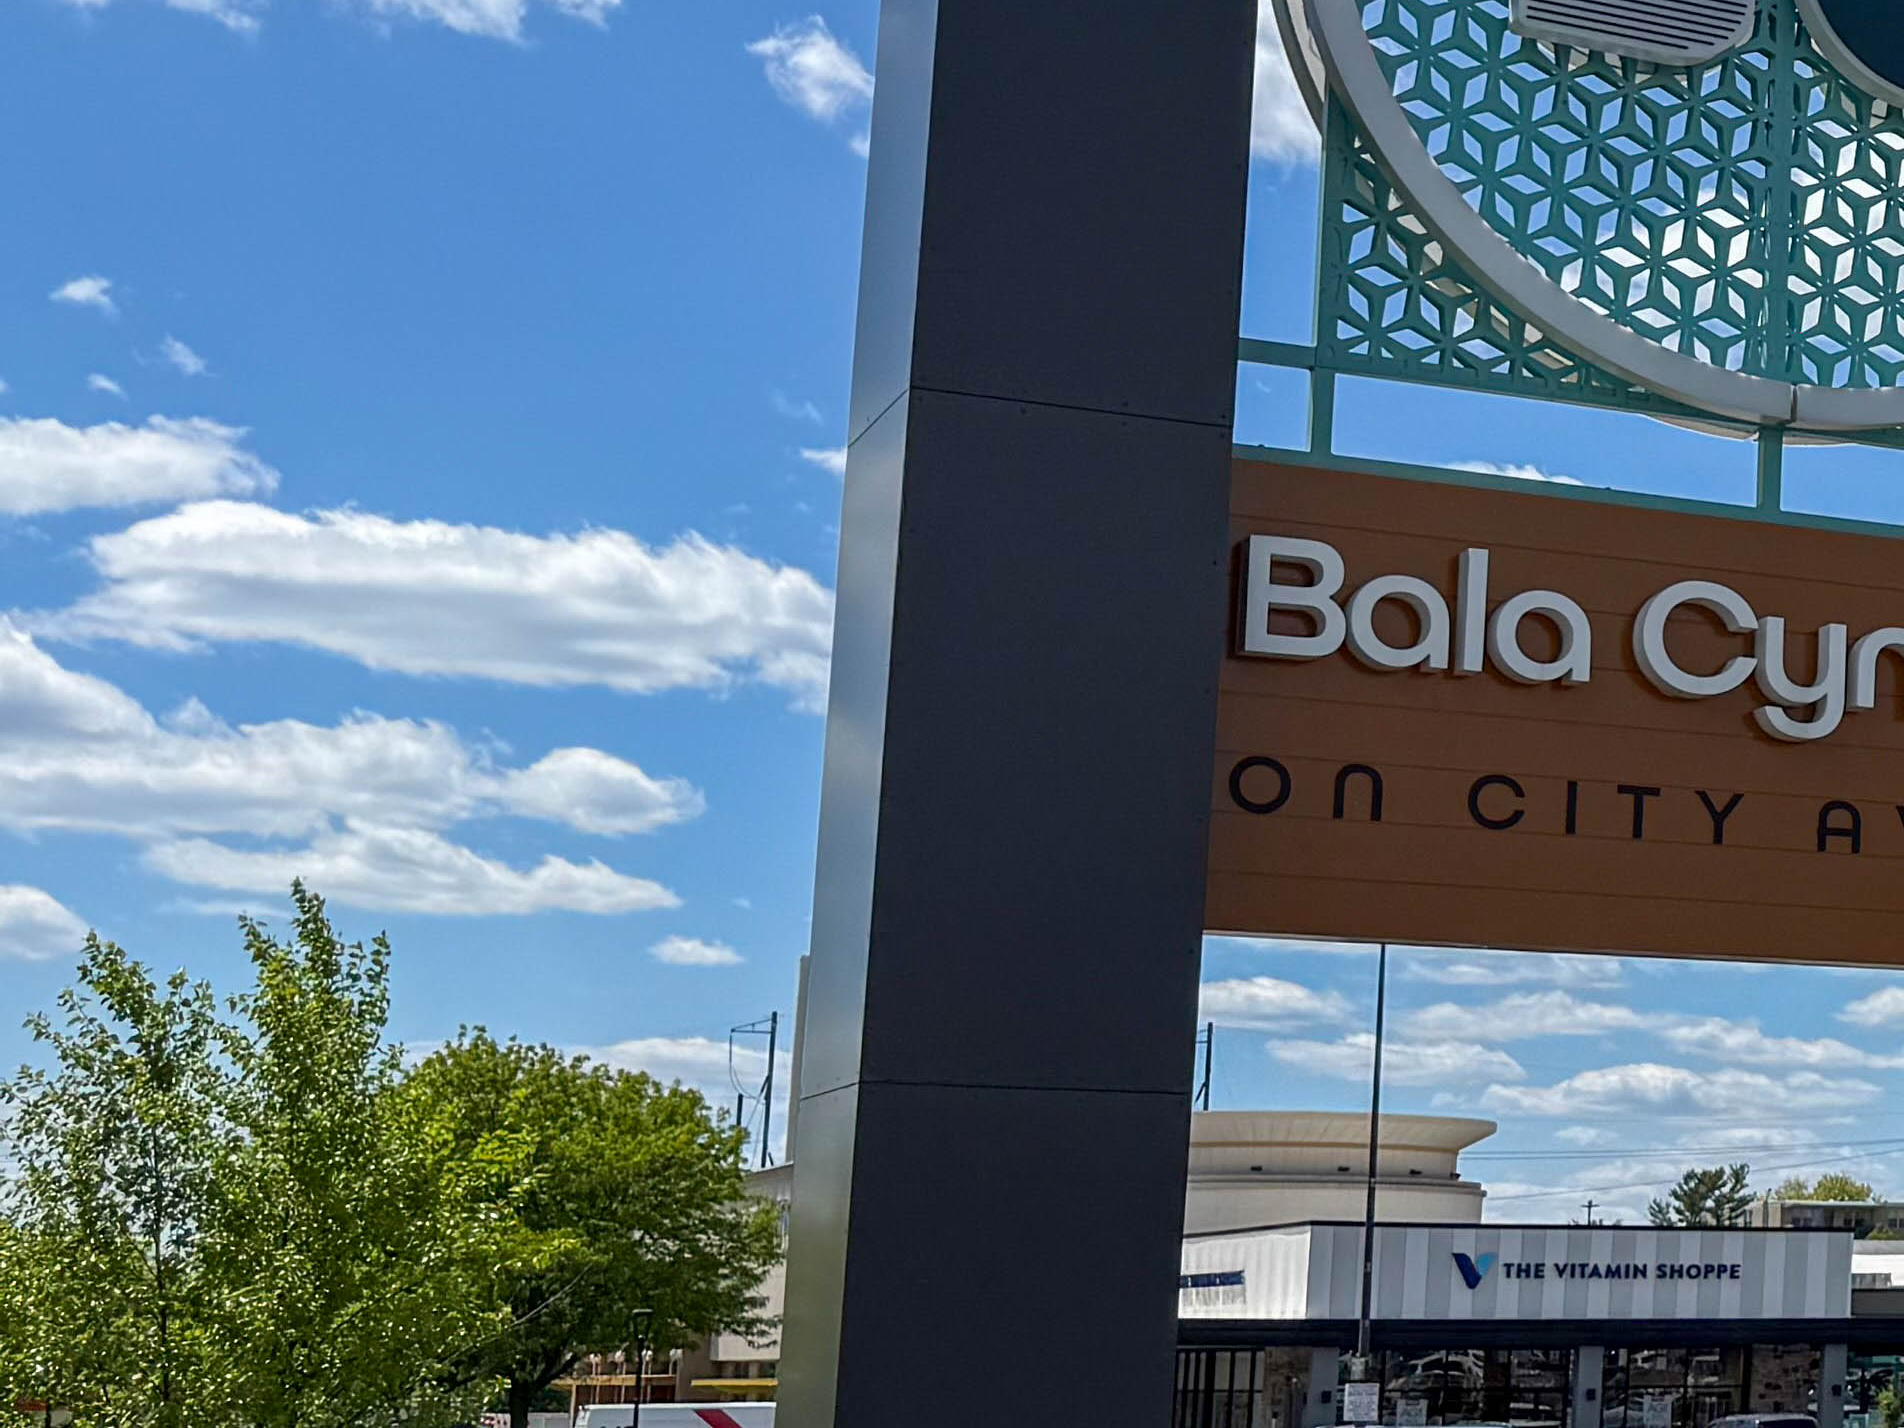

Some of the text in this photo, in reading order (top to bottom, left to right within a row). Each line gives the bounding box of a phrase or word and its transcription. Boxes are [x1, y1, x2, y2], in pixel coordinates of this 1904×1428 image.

[1239, 533, 1592, 686] Bala
[1466, 773, 1745, 846] CITY
[1503, 1262, 1742, 1281] THE VITAMIN SHOPPE
